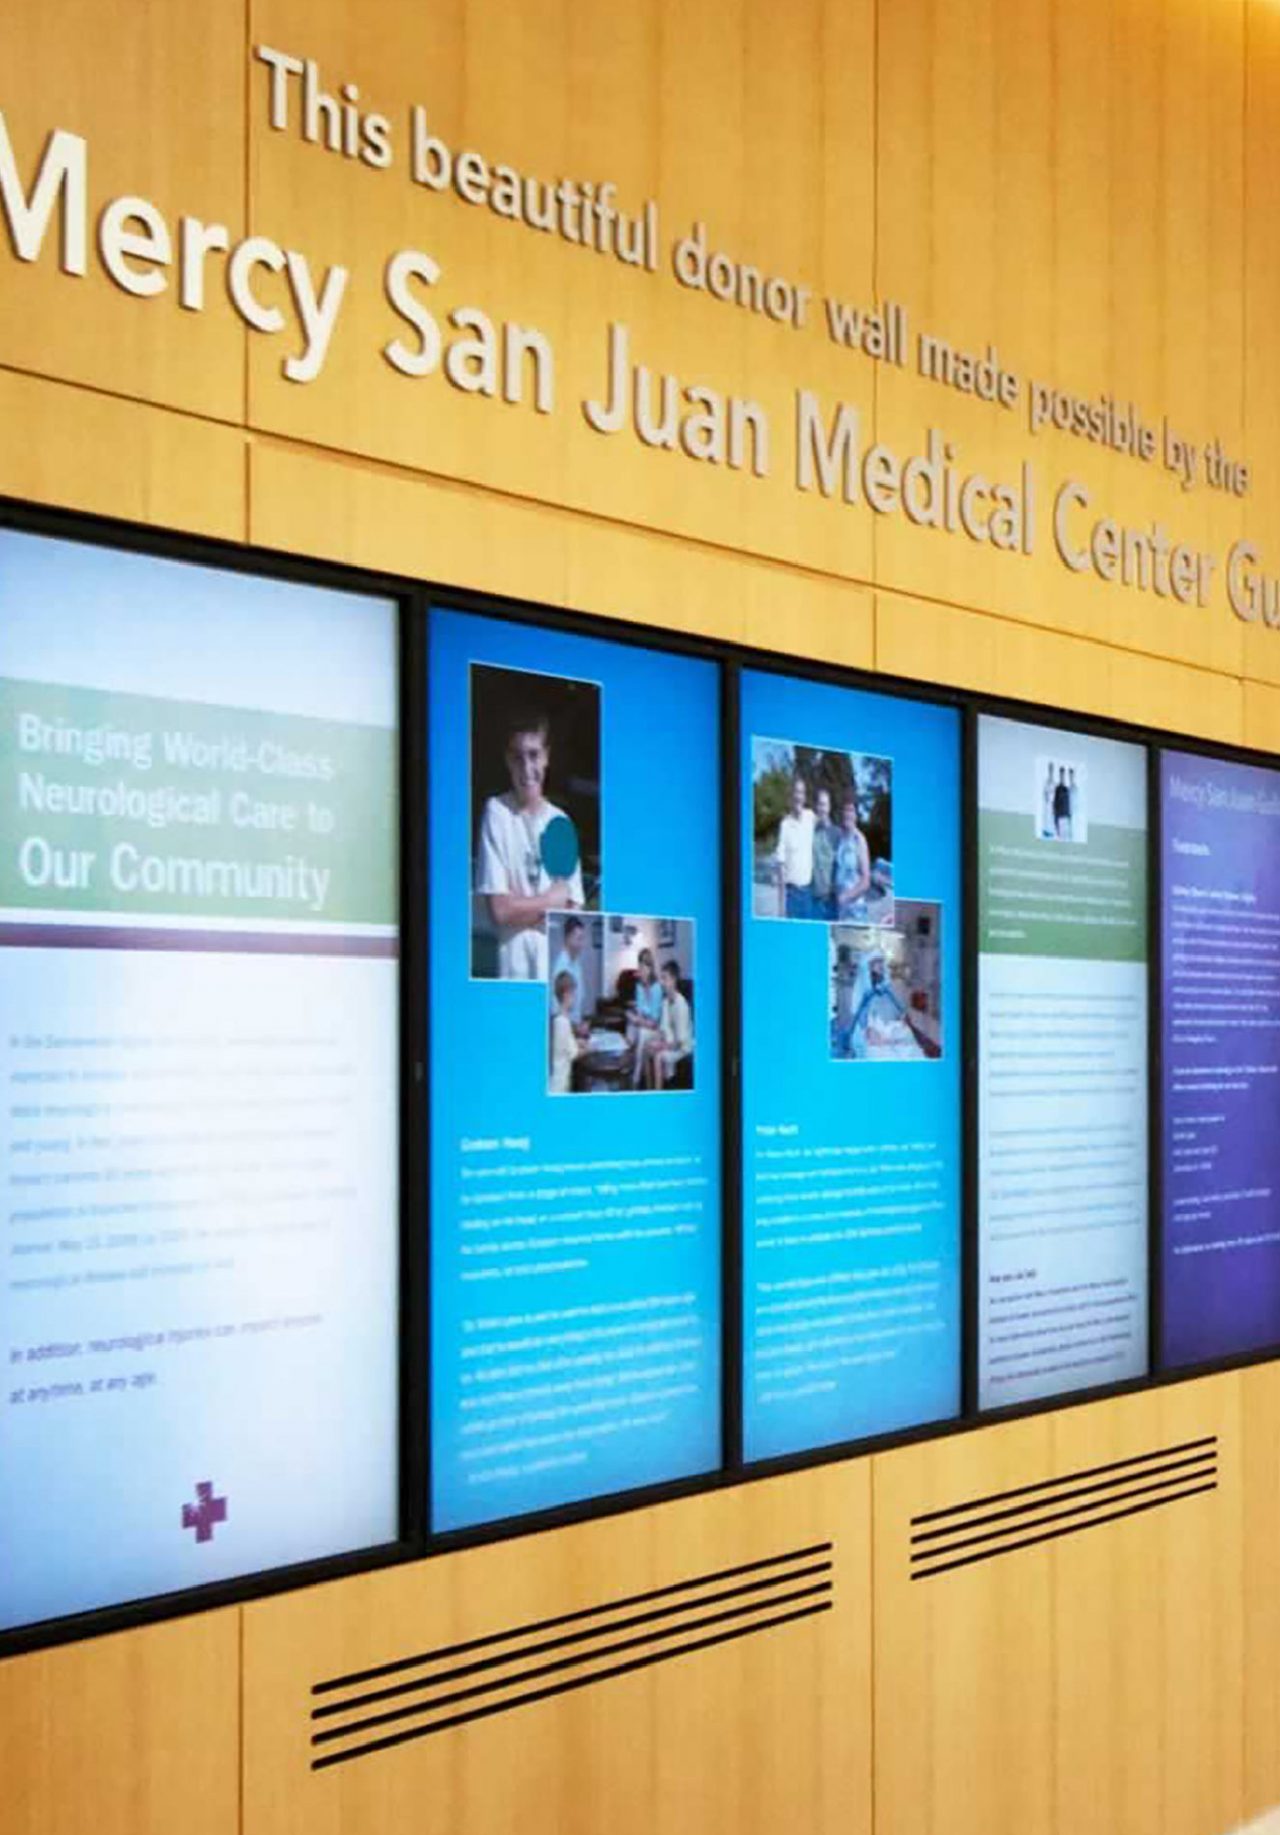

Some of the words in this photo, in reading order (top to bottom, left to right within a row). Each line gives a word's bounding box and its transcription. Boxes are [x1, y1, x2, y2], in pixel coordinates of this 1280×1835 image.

[257, 45, 393, 169] This
[411, 104, 659, 271] beautiful
[673, 221, 810, 331] donor
[824, 299, 909, 368] wall
[917, 329, 1019, 411] made
[1028, 379, 1156, 463] possible
[1163, 415, 1199, 495] by
[1203, 441, 1251, 497] the
[0, 112, 348, 384] Mercy
[382, 249, 556, 414] San
[582, 323, 771, 477] Juan
[795, 388, 1035, 556] Medical
[1052, 481, 1216, 609] Center
[18, 712, 152, 770] Bringing
[162, 730, 335, 782] World-Class
[18, 771, 220, 828] Neurological
[229, 791, 296, 832] Care
[307, 802, 335, 834] to
[18, 836, 97, 889] Our
[109, 842, 331, 911] Community
